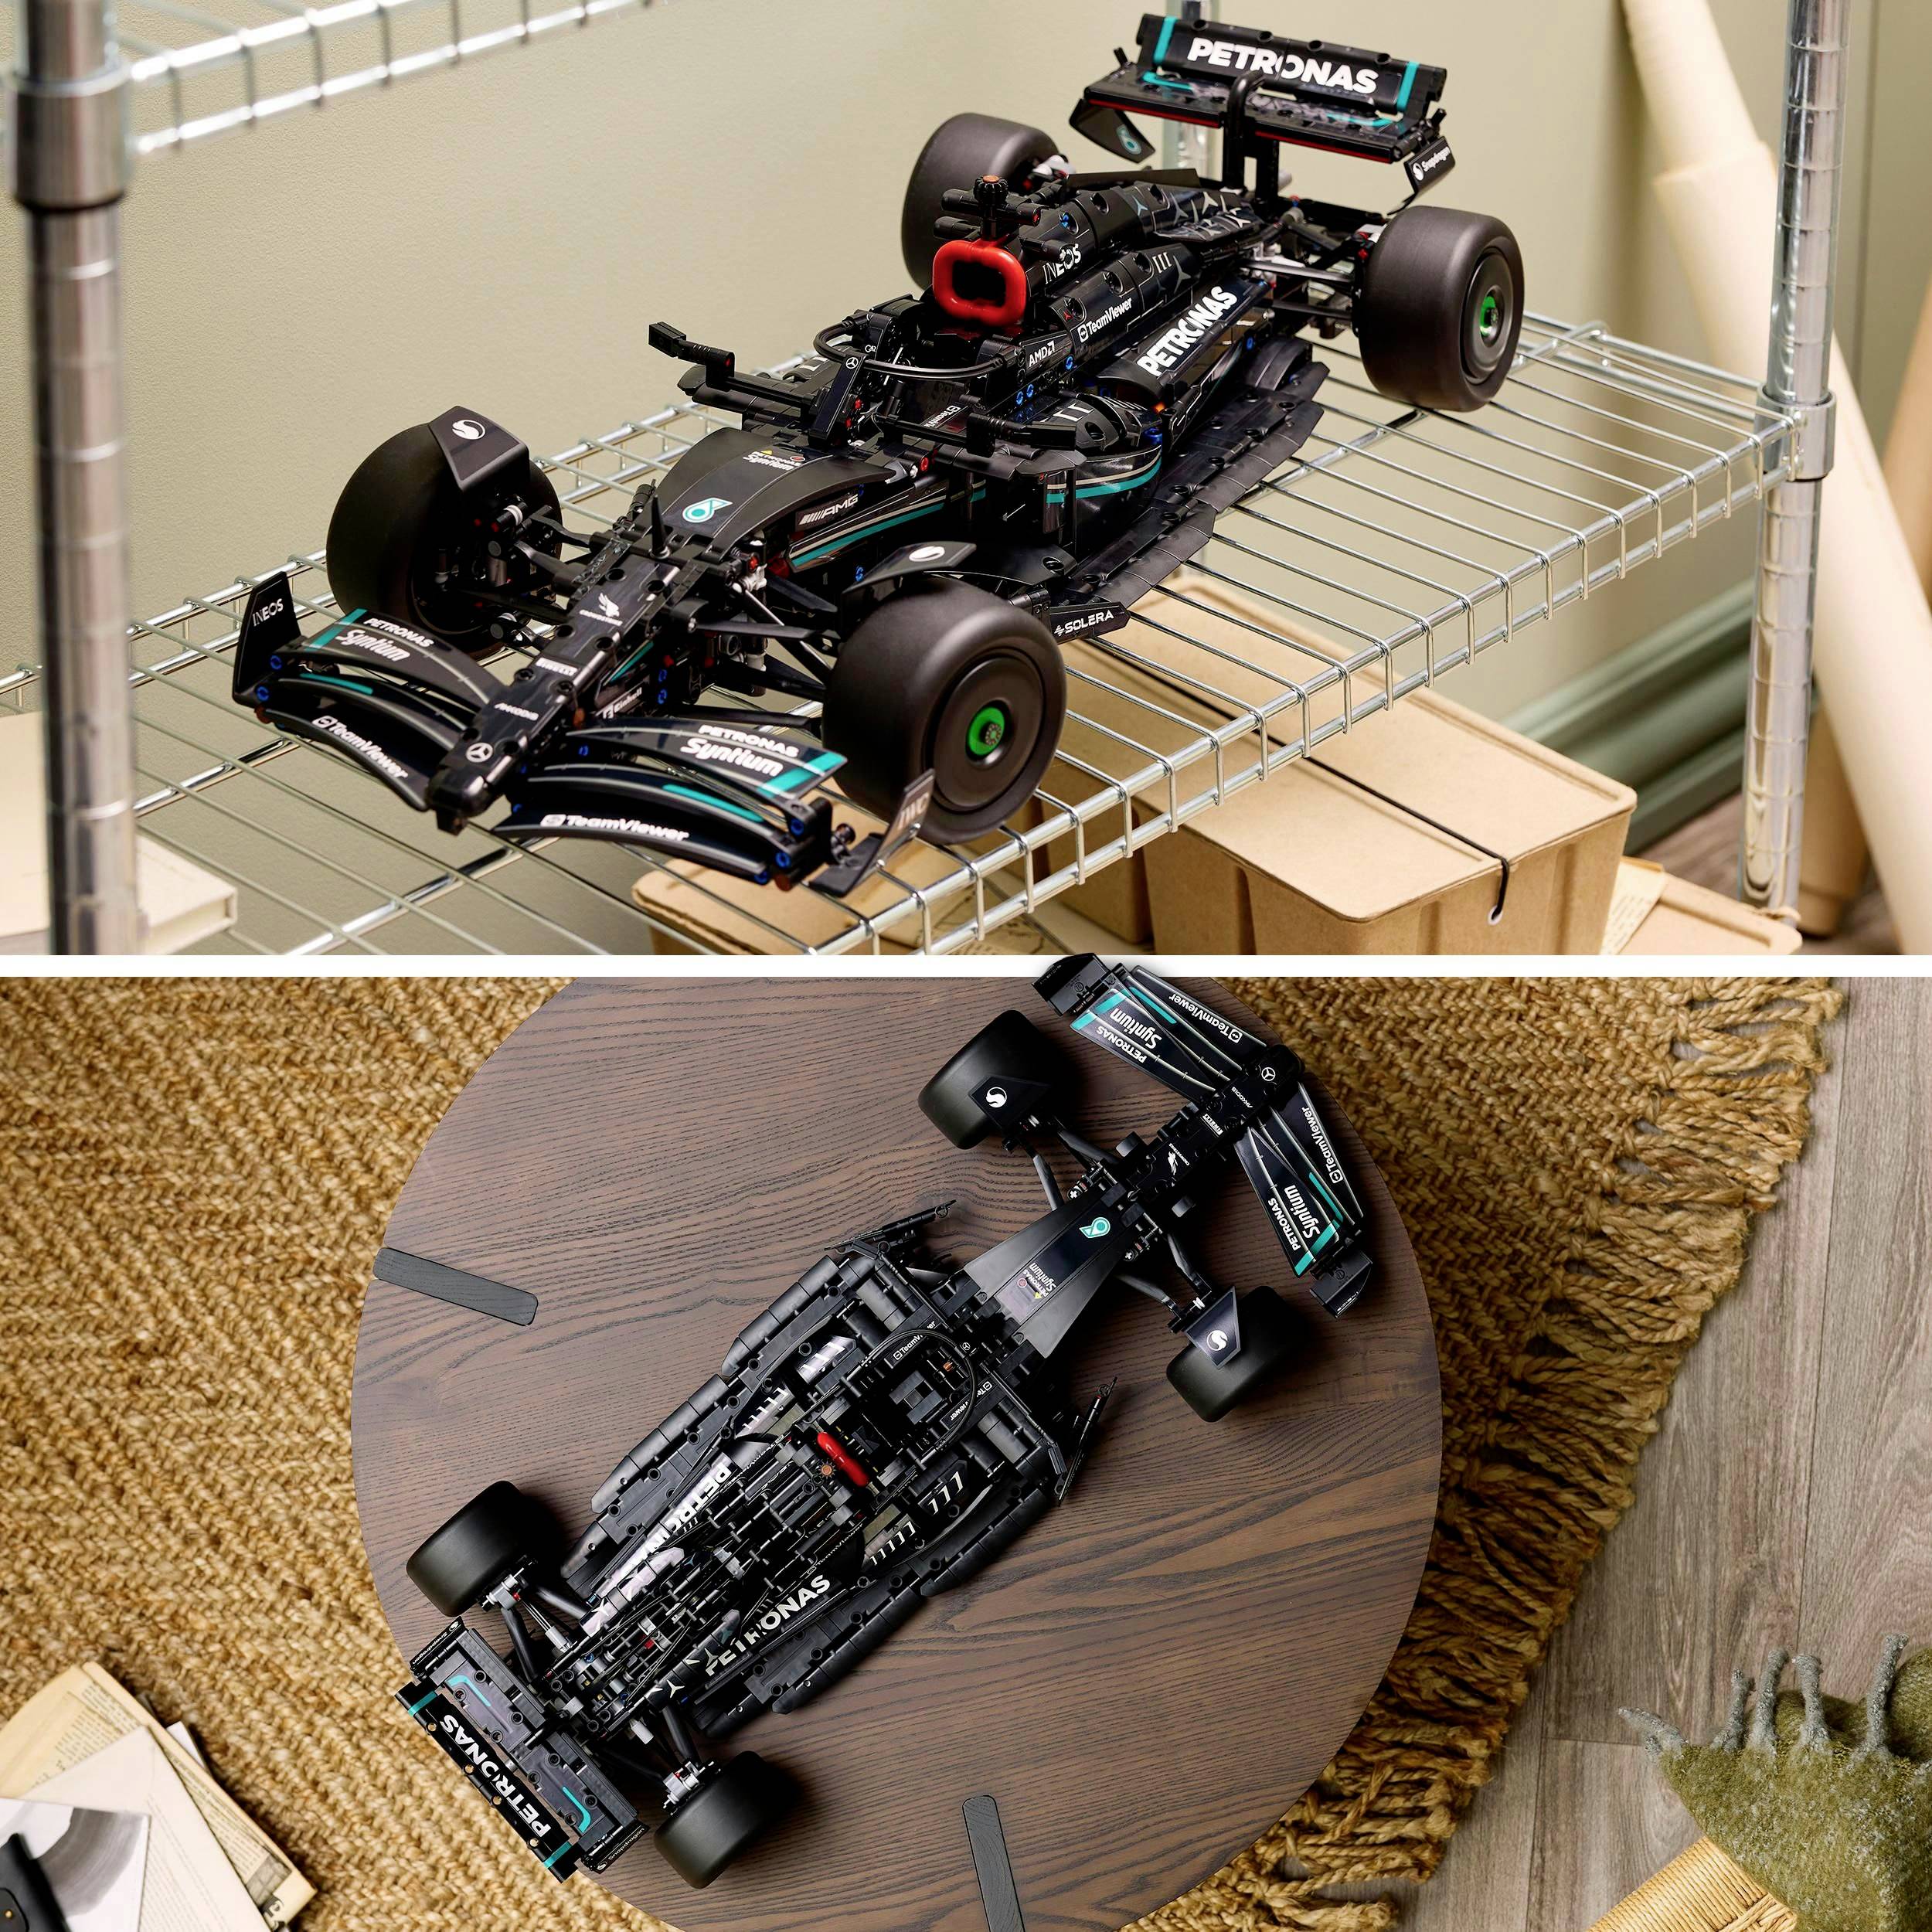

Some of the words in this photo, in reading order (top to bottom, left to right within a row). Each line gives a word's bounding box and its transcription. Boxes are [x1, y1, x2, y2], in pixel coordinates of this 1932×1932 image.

[1187, 37, 1379, 94] PETRONAS
[1086, 297, 1132, 335] TeamViewer
[1136, 285, 1237, 376] PETRONAS
[252, 598, 284, 627] INEOS
[1064, 609, 1114, 634] SOLERA
[335, 629, 410, 662] Syntium
[362, 617, 434, 648] PETRONAS
[330, 722, 409, 779] TeamViewer
[680, 736, 785, 777] Syntium
[699, 724, 801, 758] PETRONAS
[564, 815, 690, 842] TeamViewer
[1110, 1008, 1162, 1049] Syntium
[1168, 993, 1230, 1037] TeamViewer
[1096, 1026, 1148, 1063] PETRONAS
[1301, 1106, 1336, 1172] TeamViewer
[1267, 1197, 1301, 1251] PETRONAS
[1284, 1184, 1321, 1239] Syntium
[1022, 1269, 1049, 1298] PETRONAS
[1029, 1262, 1057, 1292] Syntium
[439, 1714, 552, 1838] PETRONAS
[607, 1828, 645, 1861] Snapdragon
